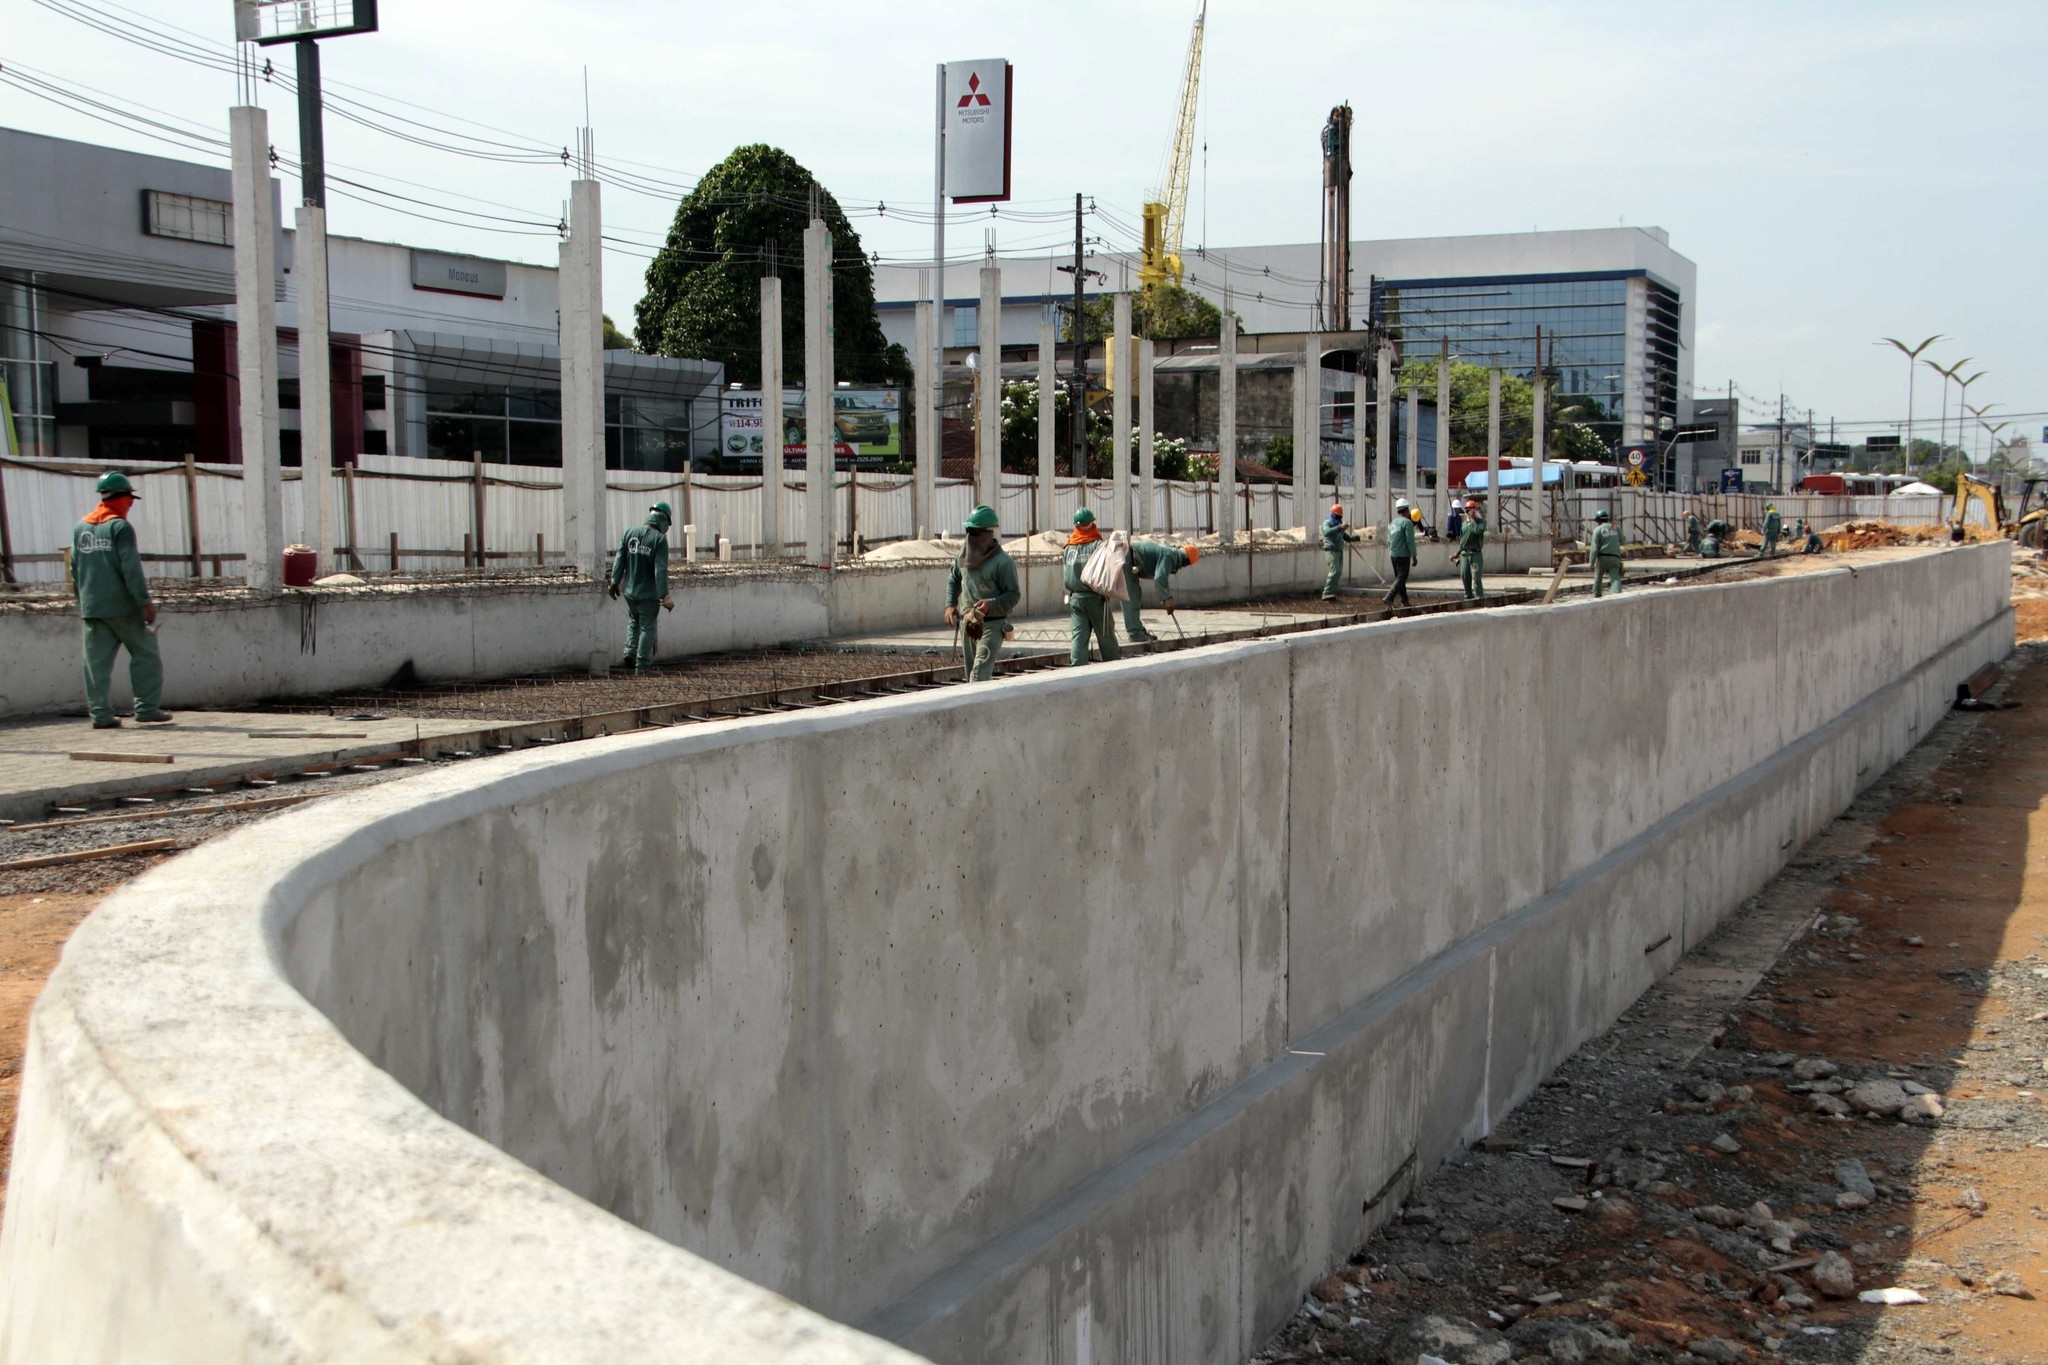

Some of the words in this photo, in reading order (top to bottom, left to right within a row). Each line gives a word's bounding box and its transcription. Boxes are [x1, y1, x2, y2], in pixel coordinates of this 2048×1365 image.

[962, 116, 985, 124] MOTORS
[448, 268, 479, 283] Manaus
[1630, 452, 1641, 460] 40
